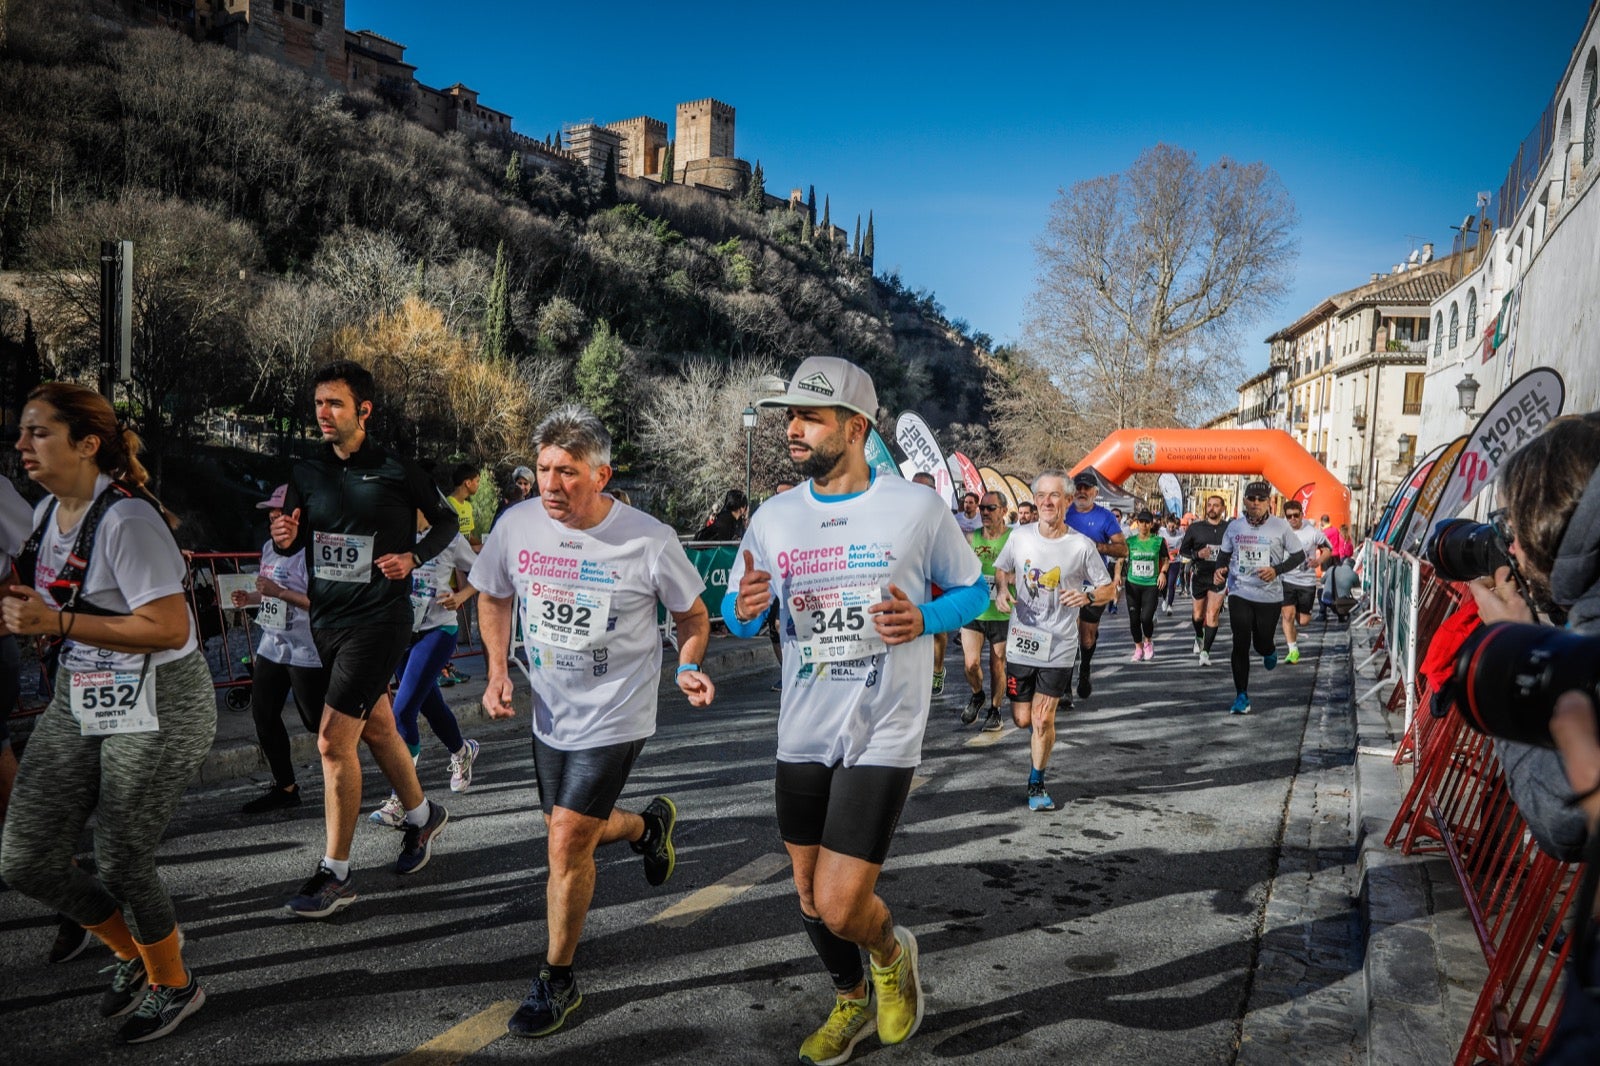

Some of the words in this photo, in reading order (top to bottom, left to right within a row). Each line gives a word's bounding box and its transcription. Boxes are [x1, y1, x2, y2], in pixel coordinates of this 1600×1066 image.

[1479, 390, 1546, 452] MODEL
[1489, 400, 1552, 468] PLAST
[322, 545, 359, 563] 619
[518, 550, 530, 574] 9
[532, 552, 578, 568] Carrera
[777, 551, 790, 579] 9
[790, 546, 844, 562] Carrera
[790, 557, 846, 578] Solidaria
[848, 560, 888, 569] Granada
[528, 564, 579, 580] Solidaria
[580, 574, 615, 584] Granada
[711, 568, 732, 586] CA
[532, 582, 541, 596] 9
[542, 585, 574, 597] Carrera
[541, 592, 575, 605] Solidaria
[793, 596, 806, 612] 9
[805, 592, 839, 603] Carrera
[806, 600, 842, 611] Solidaria
[260, 602, 277, 614] 496
[542, 600, 591, 628] 392
[541, 620, 572, 633] FRANCISCO
[811, 606, 864, 634] 345
[820, 636, 834, 644] JOSE
[834, 634, 862, 643] MANUEL
[1016, 637, 1040, 652] 259
[556, 653, 584, 661] PUERTA
[73, 673, 81, 688] 9
[82, 684, 136, 709] 552
[95, 710, 126, 718] ARANTXA
